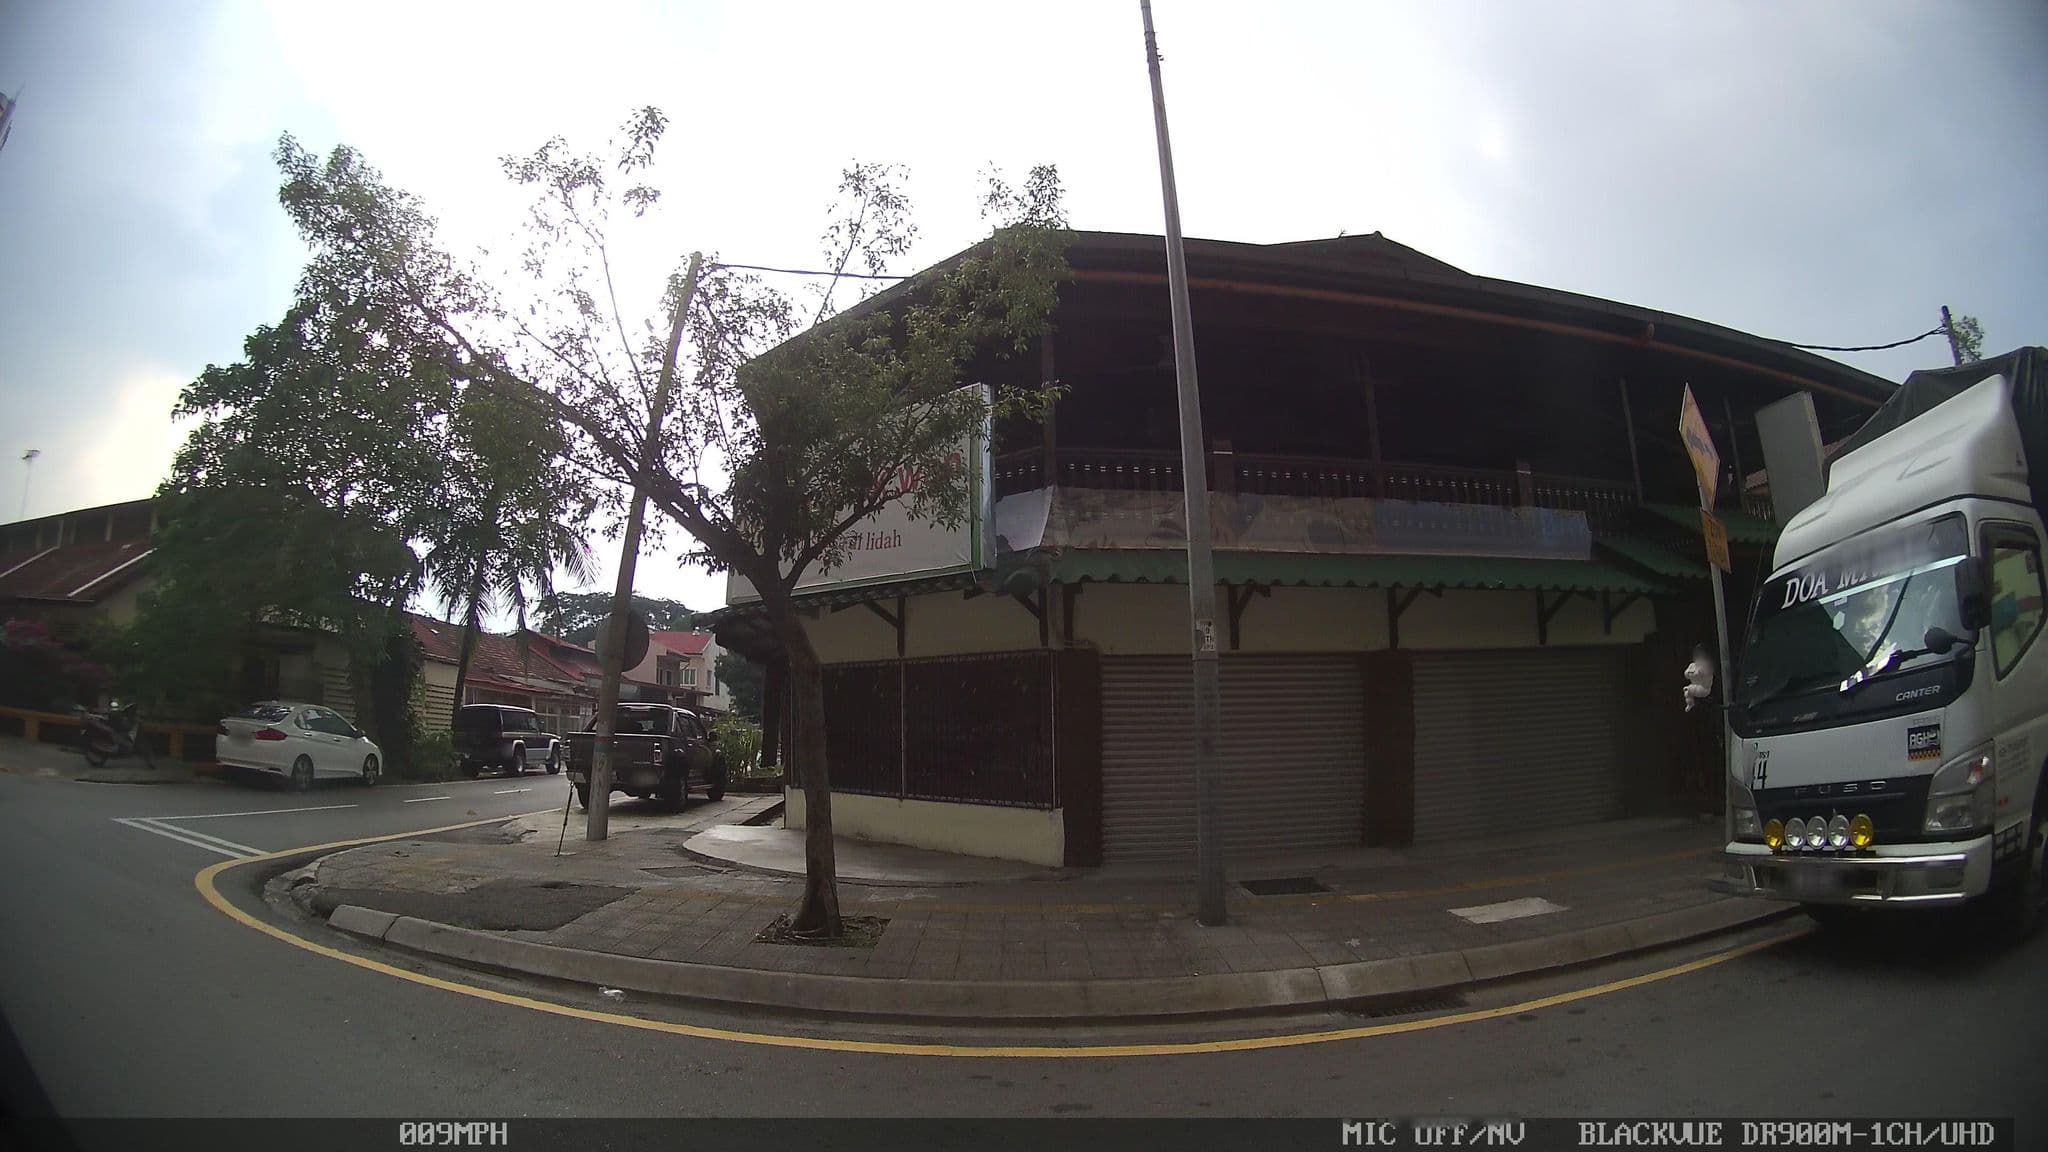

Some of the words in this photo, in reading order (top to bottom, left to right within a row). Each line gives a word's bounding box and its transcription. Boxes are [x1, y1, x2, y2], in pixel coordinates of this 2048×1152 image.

[866, 529, 902, 551] lidah
[1781, 570, 1829, 610] DOA
[1896, 685, 1941, 702] CANTER
